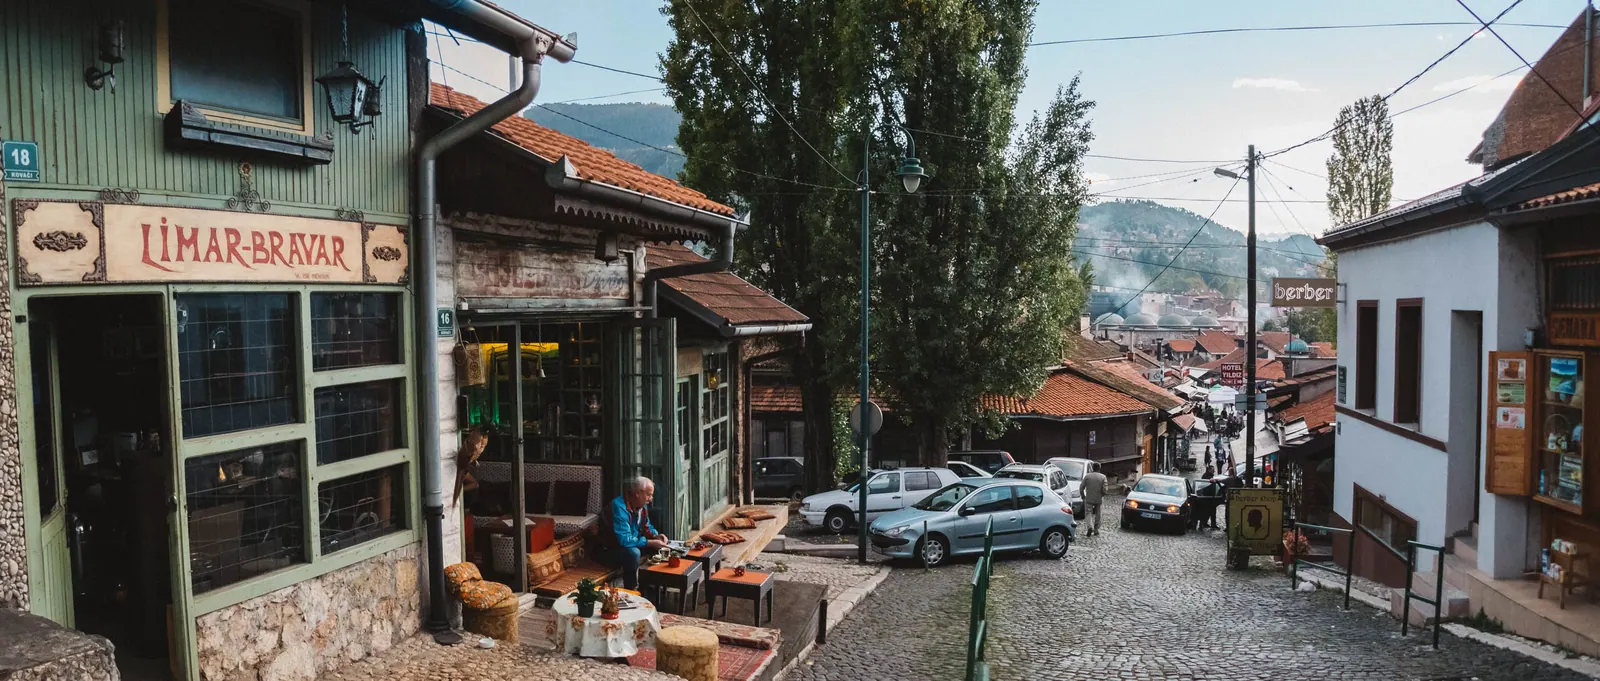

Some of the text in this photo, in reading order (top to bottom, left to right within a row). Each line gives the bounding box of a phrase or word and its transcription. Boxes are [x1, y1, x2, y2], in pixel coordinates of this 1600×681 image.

[11, 148, 30, 166] 18
[1274, 282, 1334, 301] berber
[440, 312, 450, 325] 16
